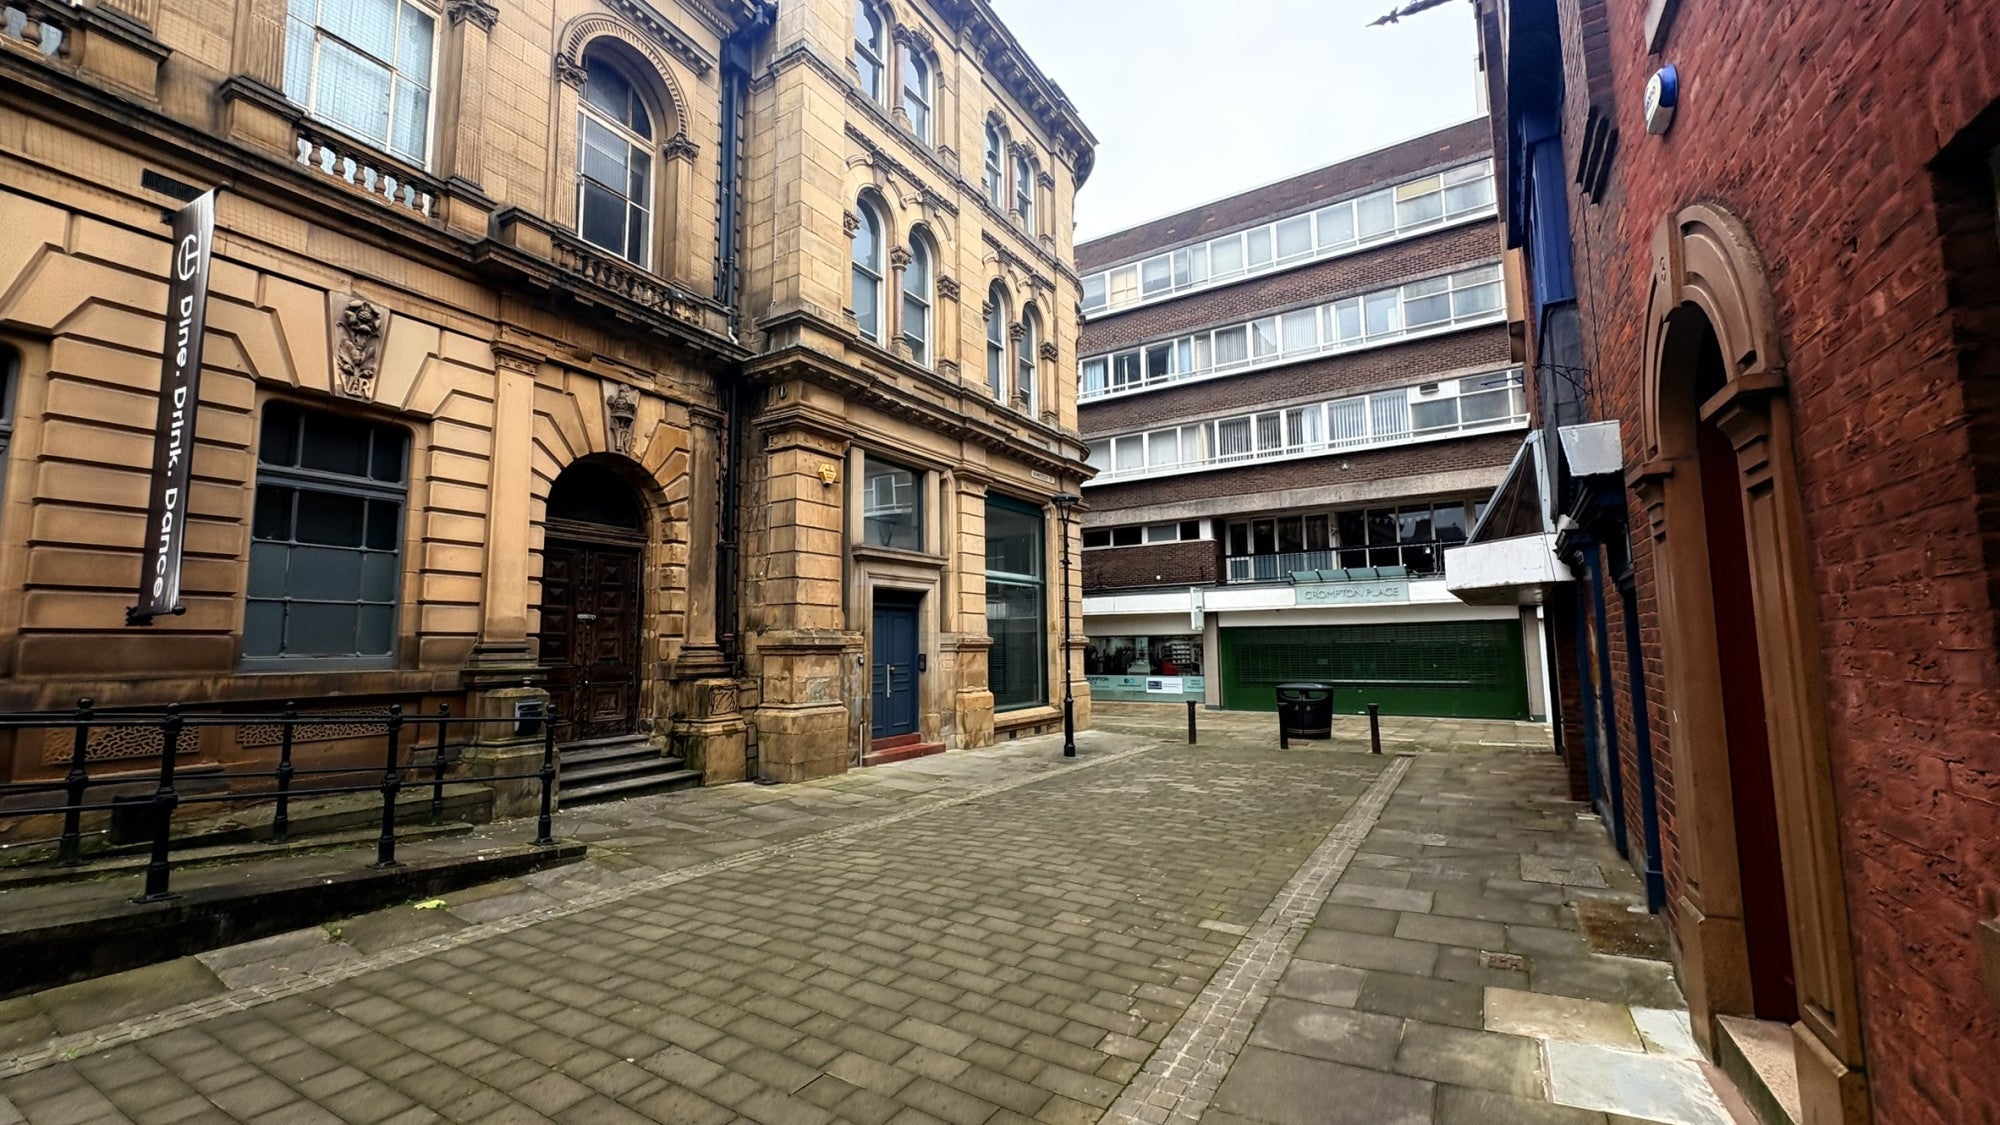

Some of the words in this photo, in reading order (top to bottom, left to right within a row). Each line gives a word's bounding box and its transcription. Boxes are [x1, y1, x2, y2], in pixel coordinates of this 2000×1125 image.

[176, 295, 193, 377] Dine.
[168, 386, 187, 477] Drink.
[151, 488, 178, 607] Dance.
[1305, 588, 1363, 600] CROMPTON
[1366, 586, 1399, 598] PLACE
